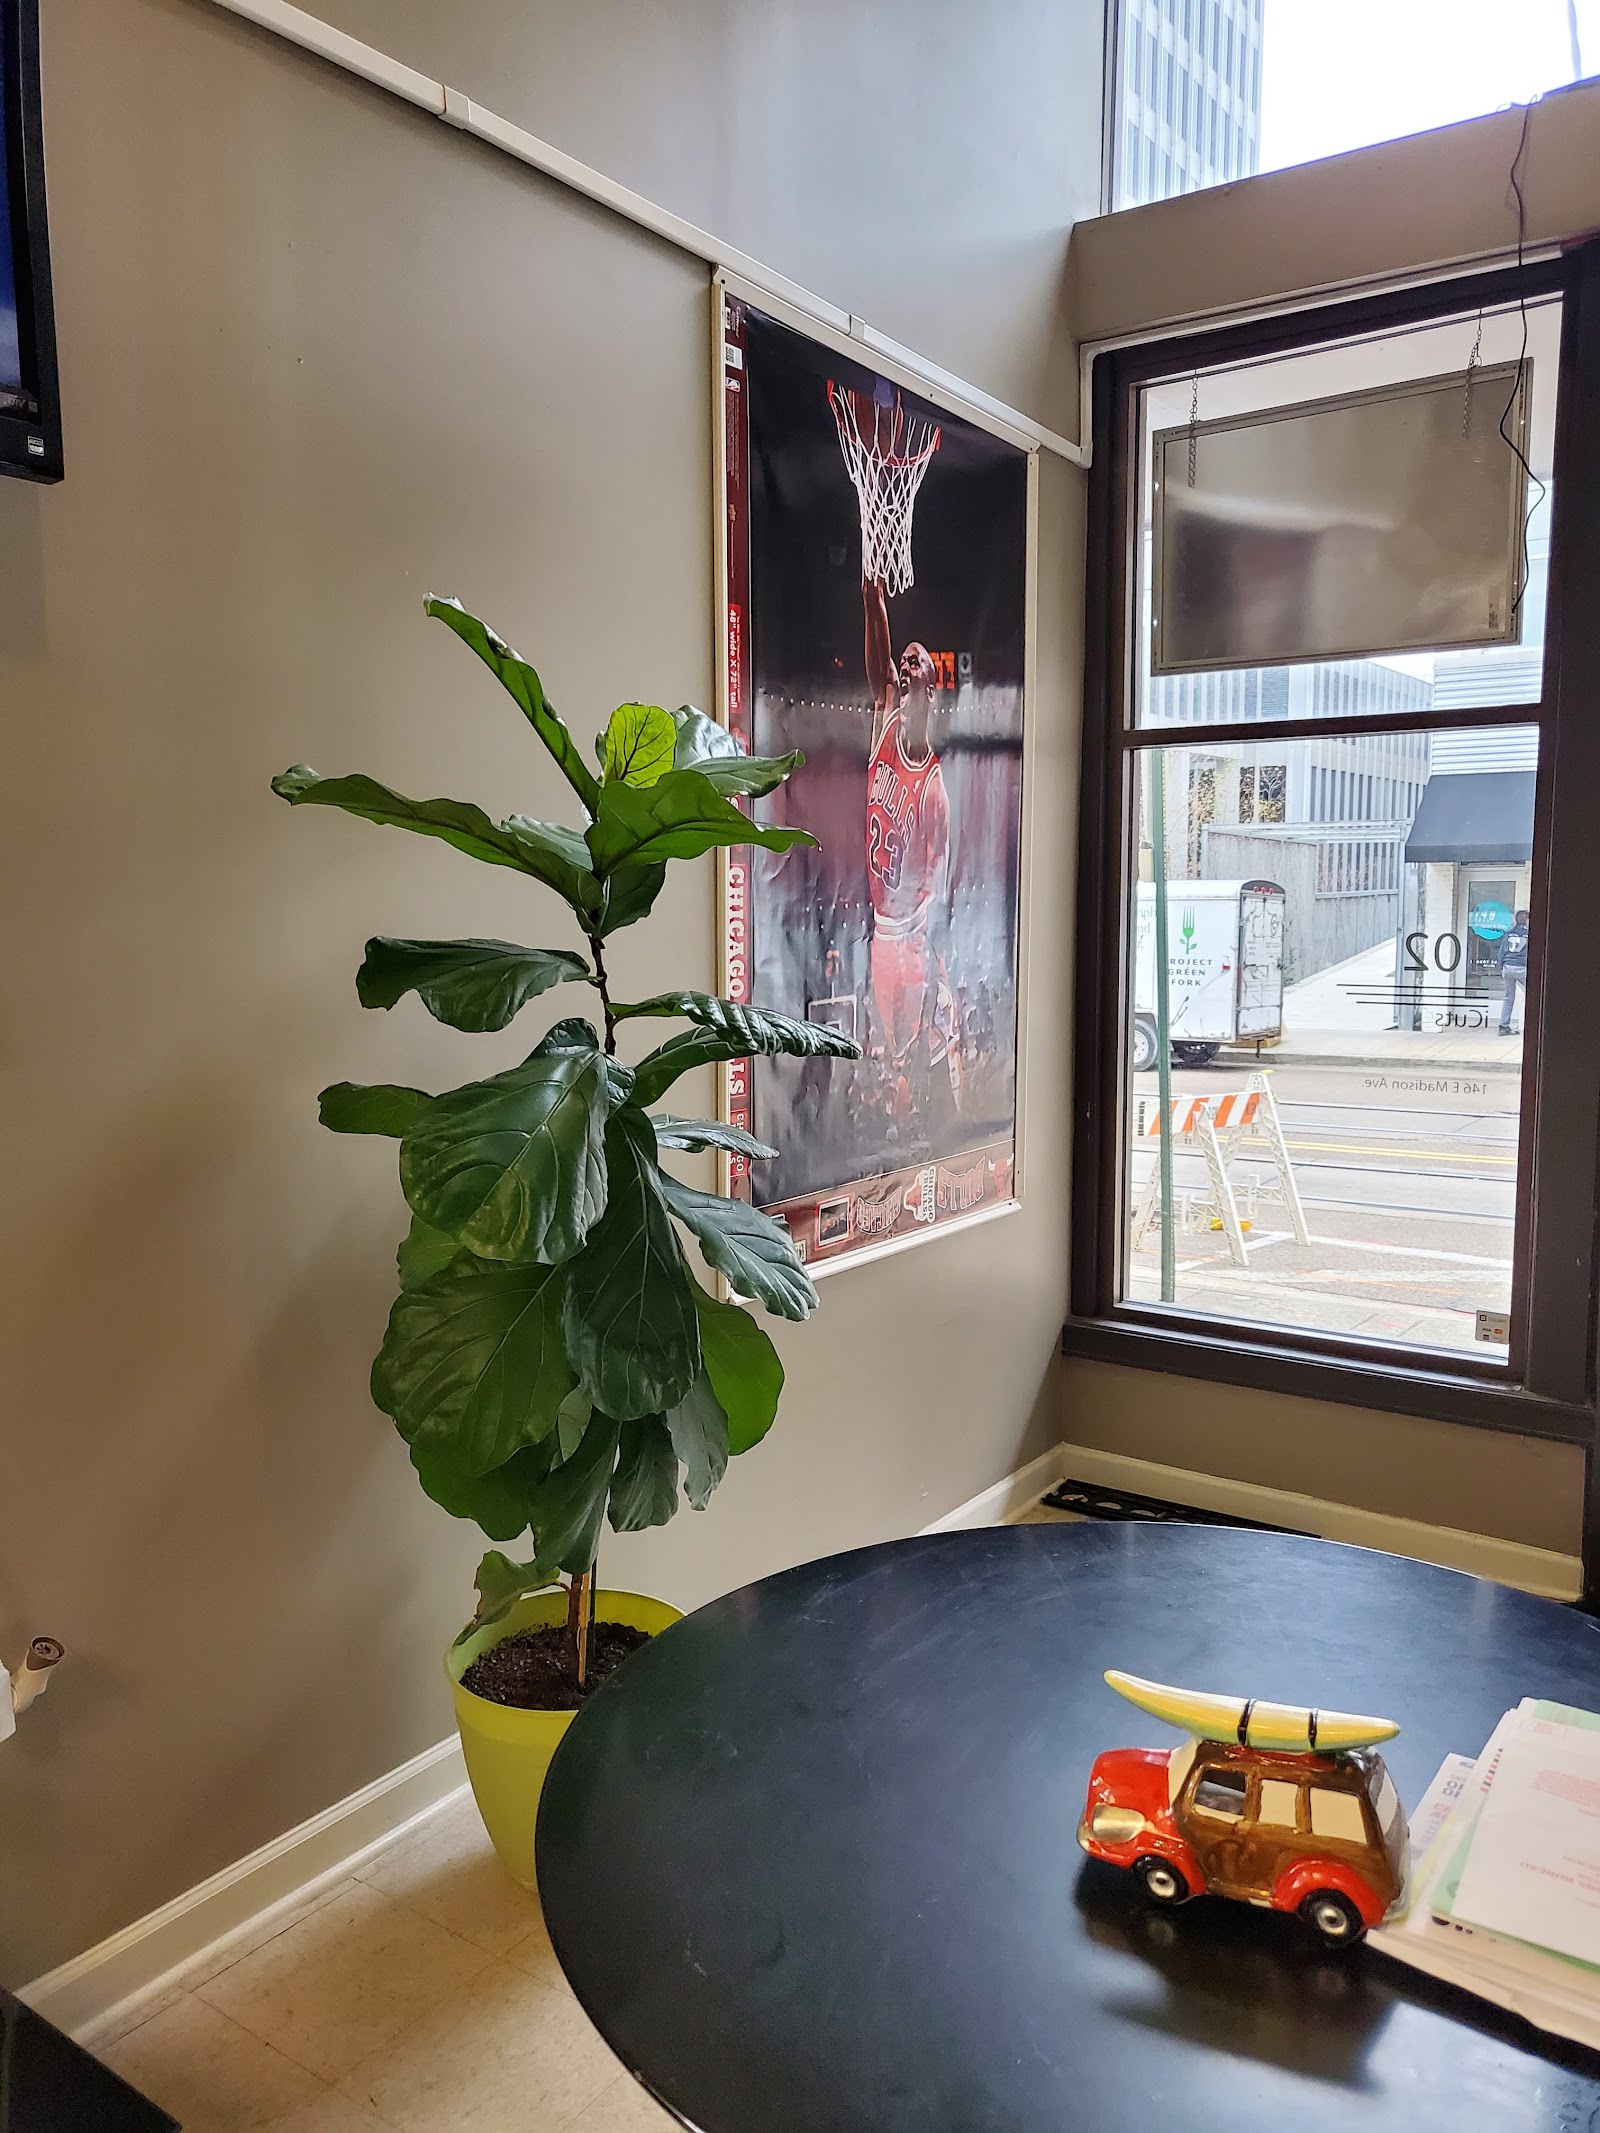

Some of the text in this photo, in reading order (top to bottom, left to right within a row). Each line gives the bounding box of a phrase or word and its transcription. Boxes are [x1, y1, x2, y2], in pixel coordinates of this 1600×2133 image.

[730, 631, 738, 656] wide
[730, 659, 737, 667] X
[730, 691, 738, 708] tall
[868, 761, 915, 852] BULLS
[870, 813, 904, 892] 23
[729, 867, 745, 998] CHICAGO
[1171, 979, 1202, 987] FORK
[736, 1113, 745, 1172] CHGO
[937, 1156, 985, 1211] BULLS
